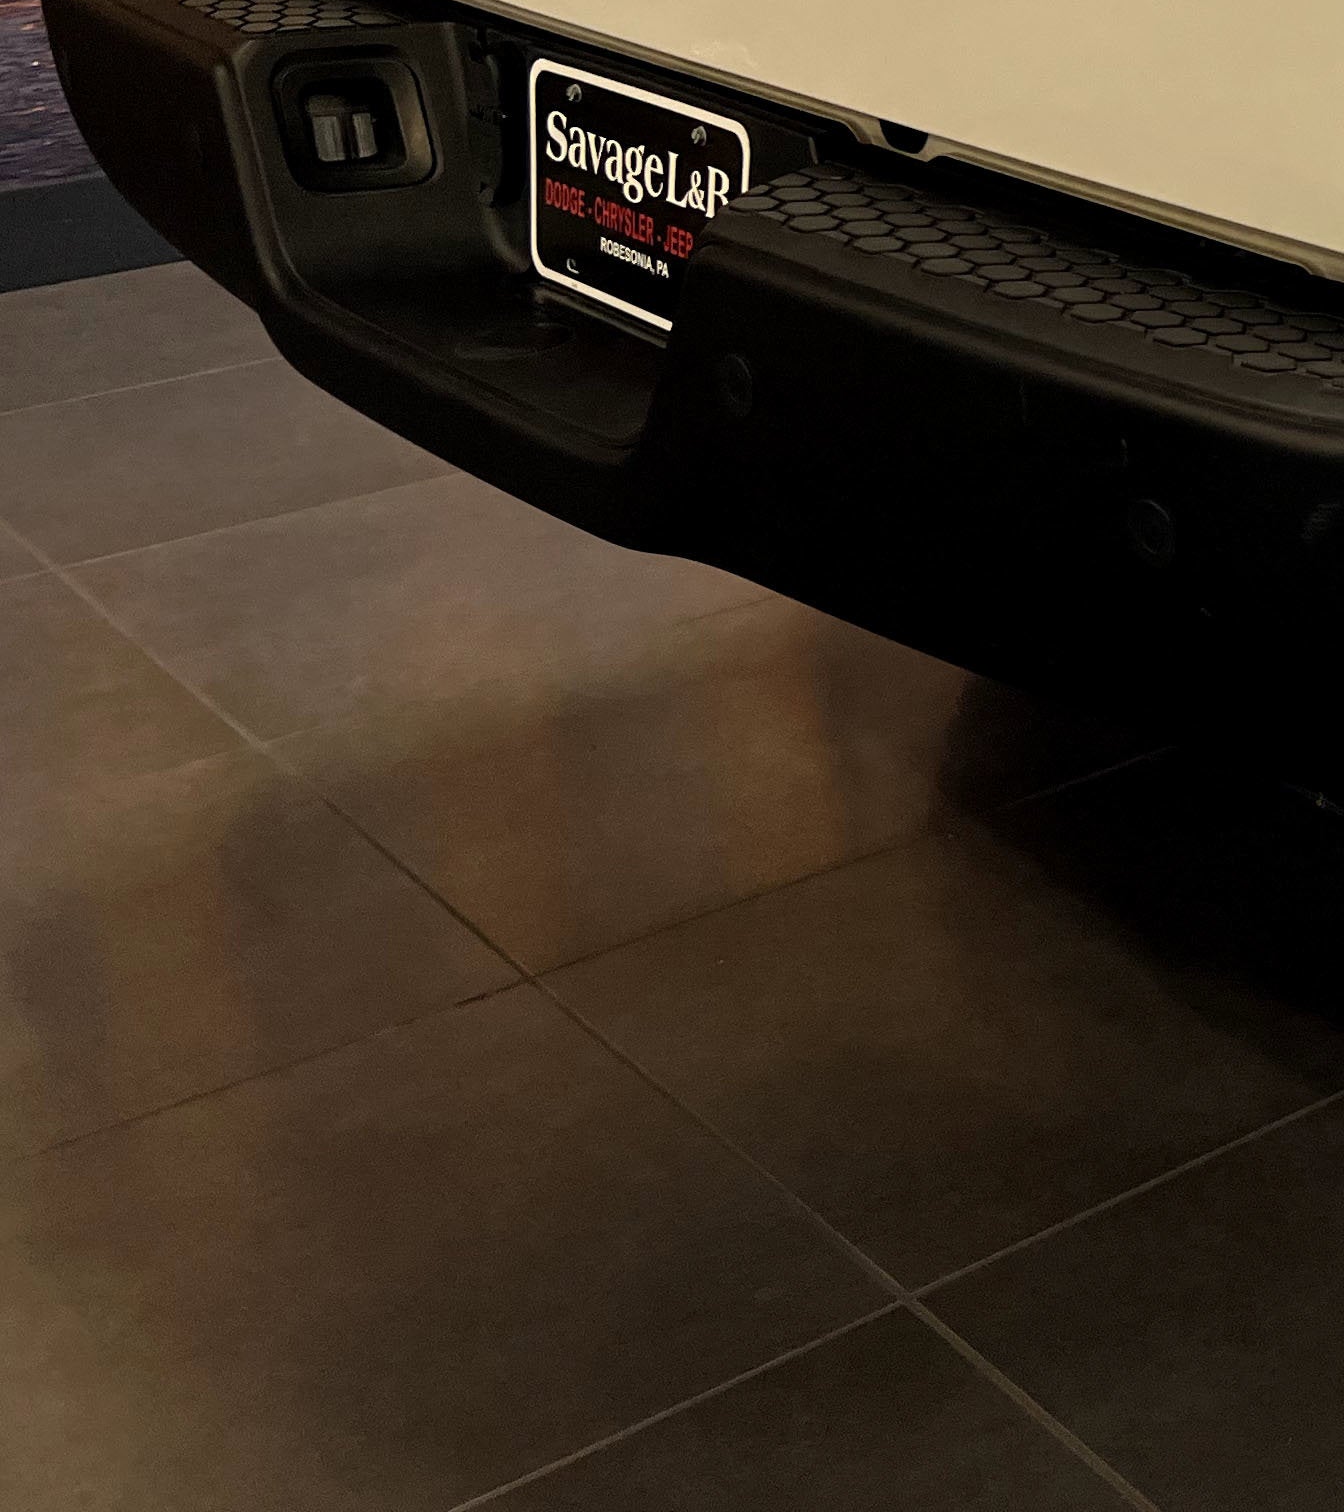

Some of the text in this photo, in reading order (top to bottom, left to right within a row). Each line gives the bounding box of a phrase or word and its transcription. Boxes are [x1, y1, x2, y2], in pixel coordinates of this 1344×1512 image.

[544, 177, 586, 219] DODGE
[594, 196, 655, 247] CHRYSLER
[663, 224, 694, 259] JEEP
[656, 259, 670, 278] PA
